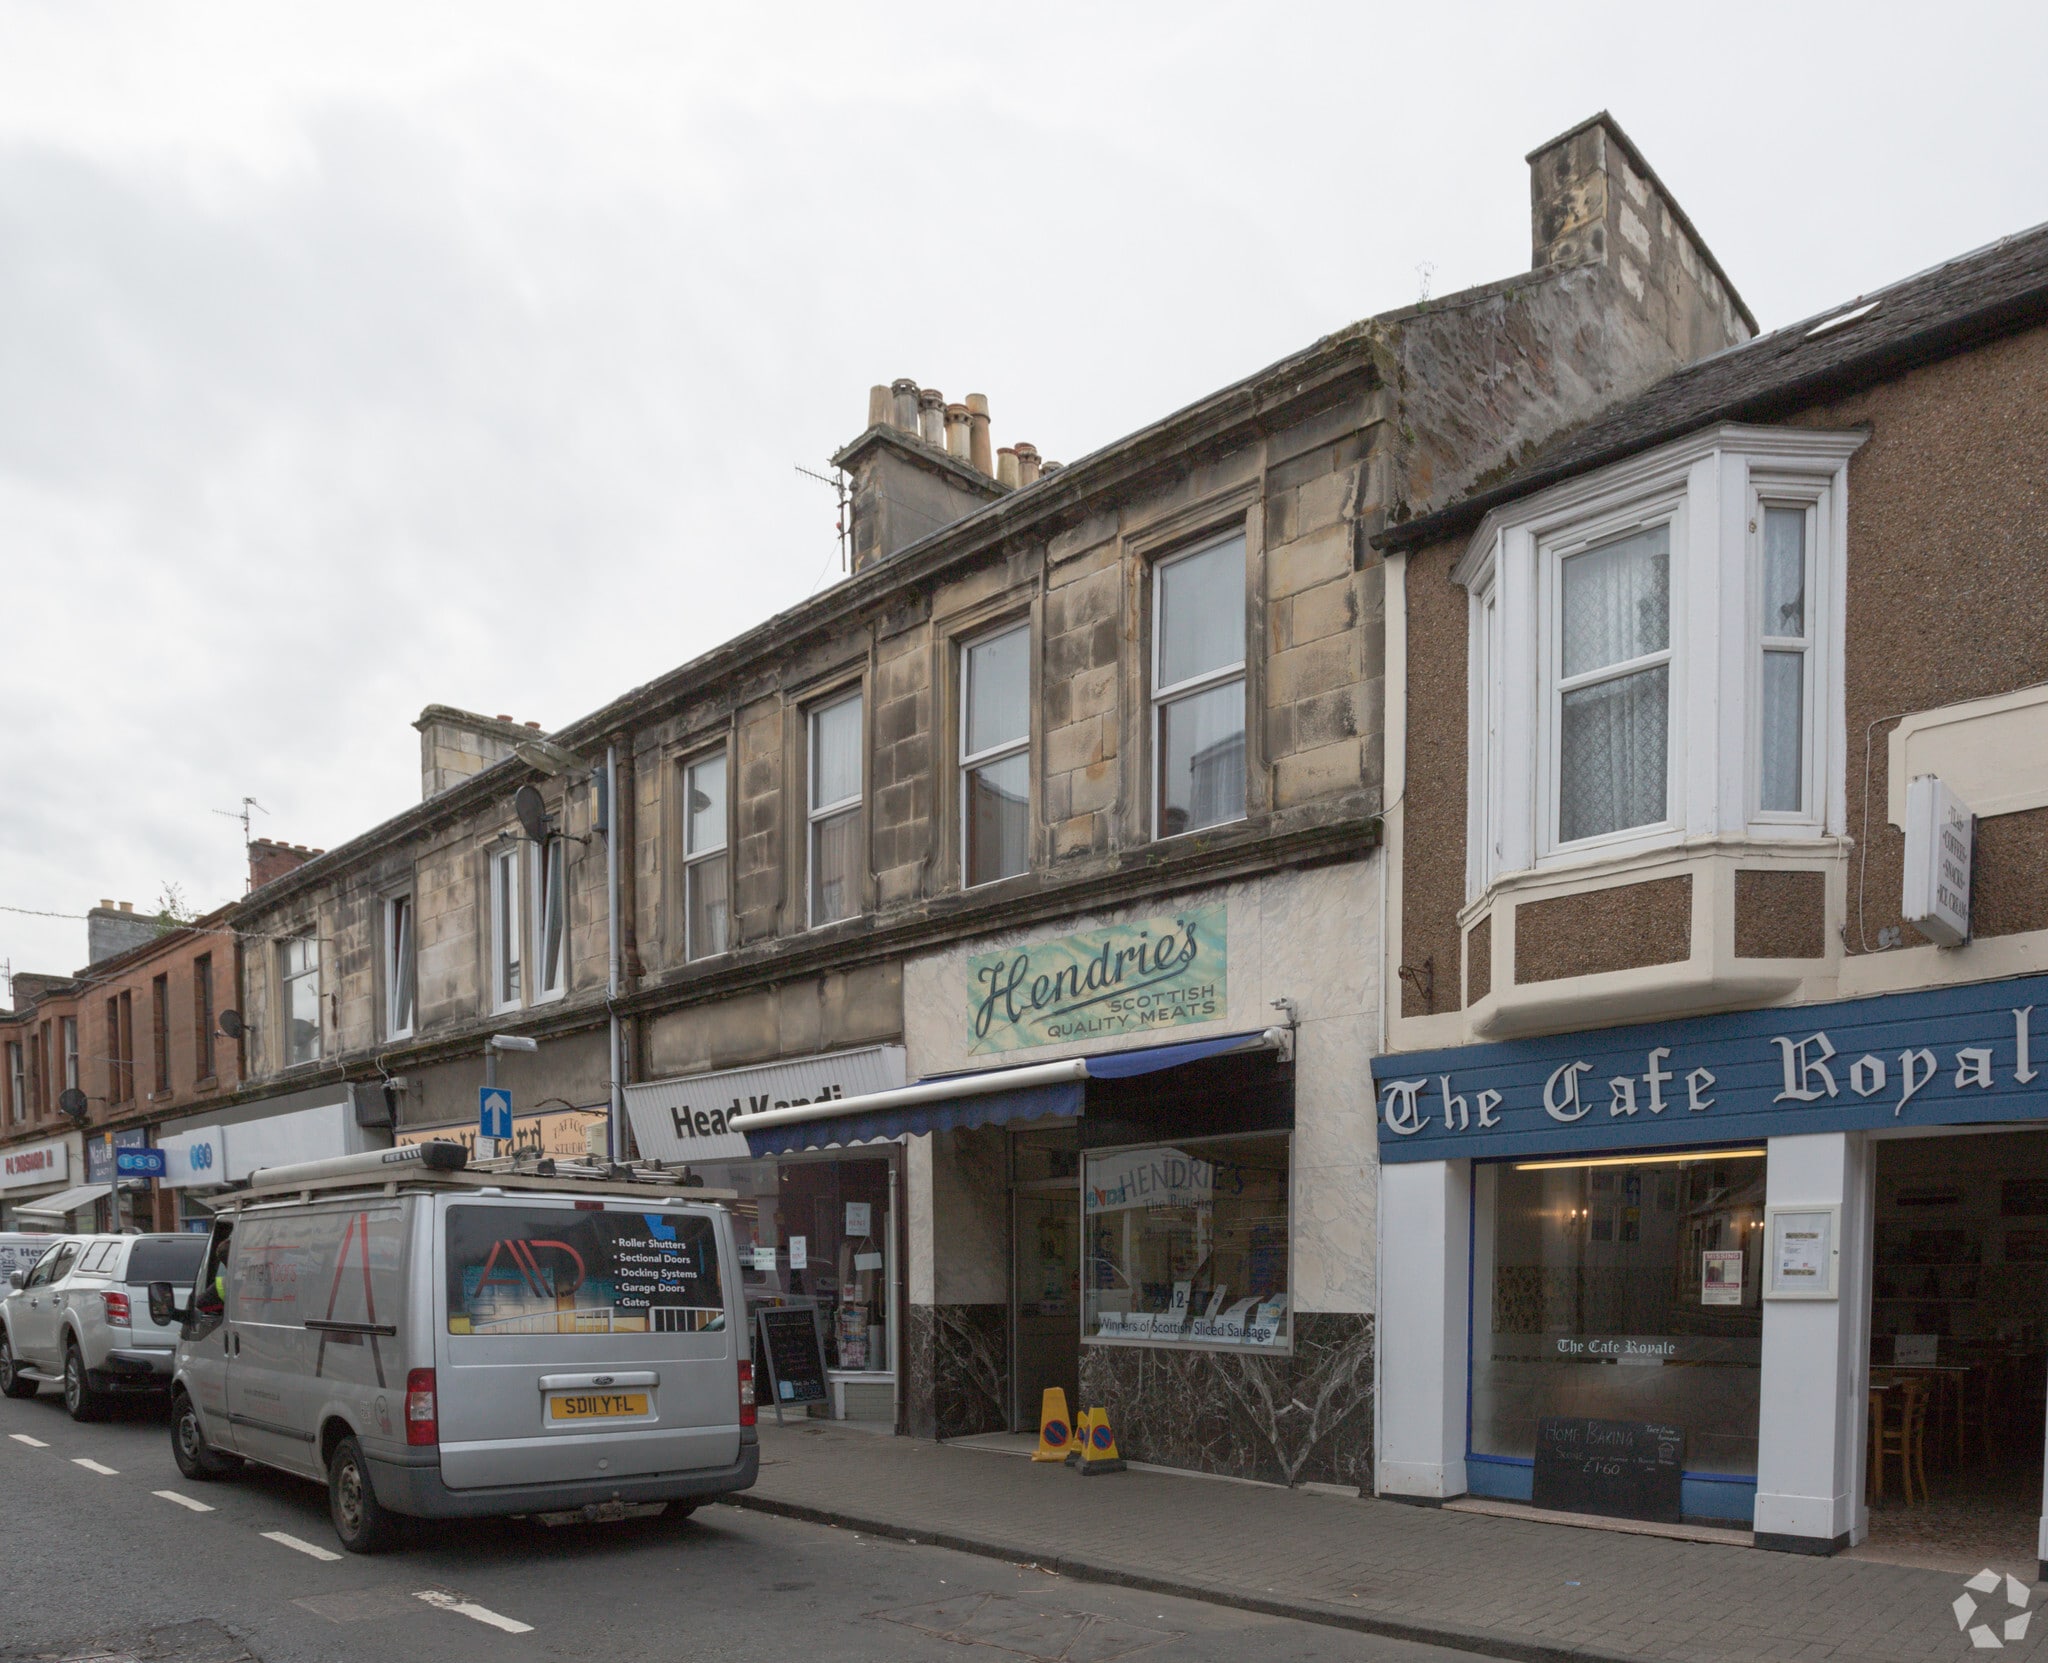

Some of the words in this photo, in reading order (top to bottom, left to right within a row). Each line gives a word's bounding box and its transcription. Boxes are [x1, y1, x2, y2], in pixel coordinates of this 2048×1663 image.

[975, 919, 1198, 1039] Hendrie's
[1110, 983, 1215, 1013] SCOTTISH
[1047, 1013, 1130, 1038] QUALITY
[1140, 1000, 1216, 1024] MEATS
[1382, 1075, 1502, 1135] The
[1543, 1047, 1716, 1123] Cafe
[1770, 1005, 2039, 1116] Royal
[554, 1141, 586, 1155] STUDIO
[121, 1156, 158, 1169] TSB
[1120, 1158, 1248, 1198] HENDRIE'S
[618, 1238, 647, 1248] Roller
[648, 1239, 686, 1250] Shutters
[619, 1253, 662, 1263] Sectional
[664, 1254, 691, 1264] Doors
[621, 1268, 659, 1280] Docking
[661, 1269, 698, 1280] Systems
[621, 1283, 656, 1294] Garage
[658, 1283, 686, 1293] Doors
[622, 1297, 651, 1307] Gates
[1100, 1317, 1137, 1334] Winners
[1139, 1319, 1150, 1333] of
[1152, 1319, 1191, 1336] Scottish
[1194, 1320, 1224, 1337] Sliced
[1227, 1322, 1271, 1342] Sausage
[1557, 1339, 1584, 1354] The
[1588, 1339, 1620, 1354] Cafe
[1625, 1340, 1676, 1357] Royale
[565, 1397, 597, 1415] SD11
[601, 1395, 634, 1413] YTL
[1586, 1421, 1634, 1446] BAKING
